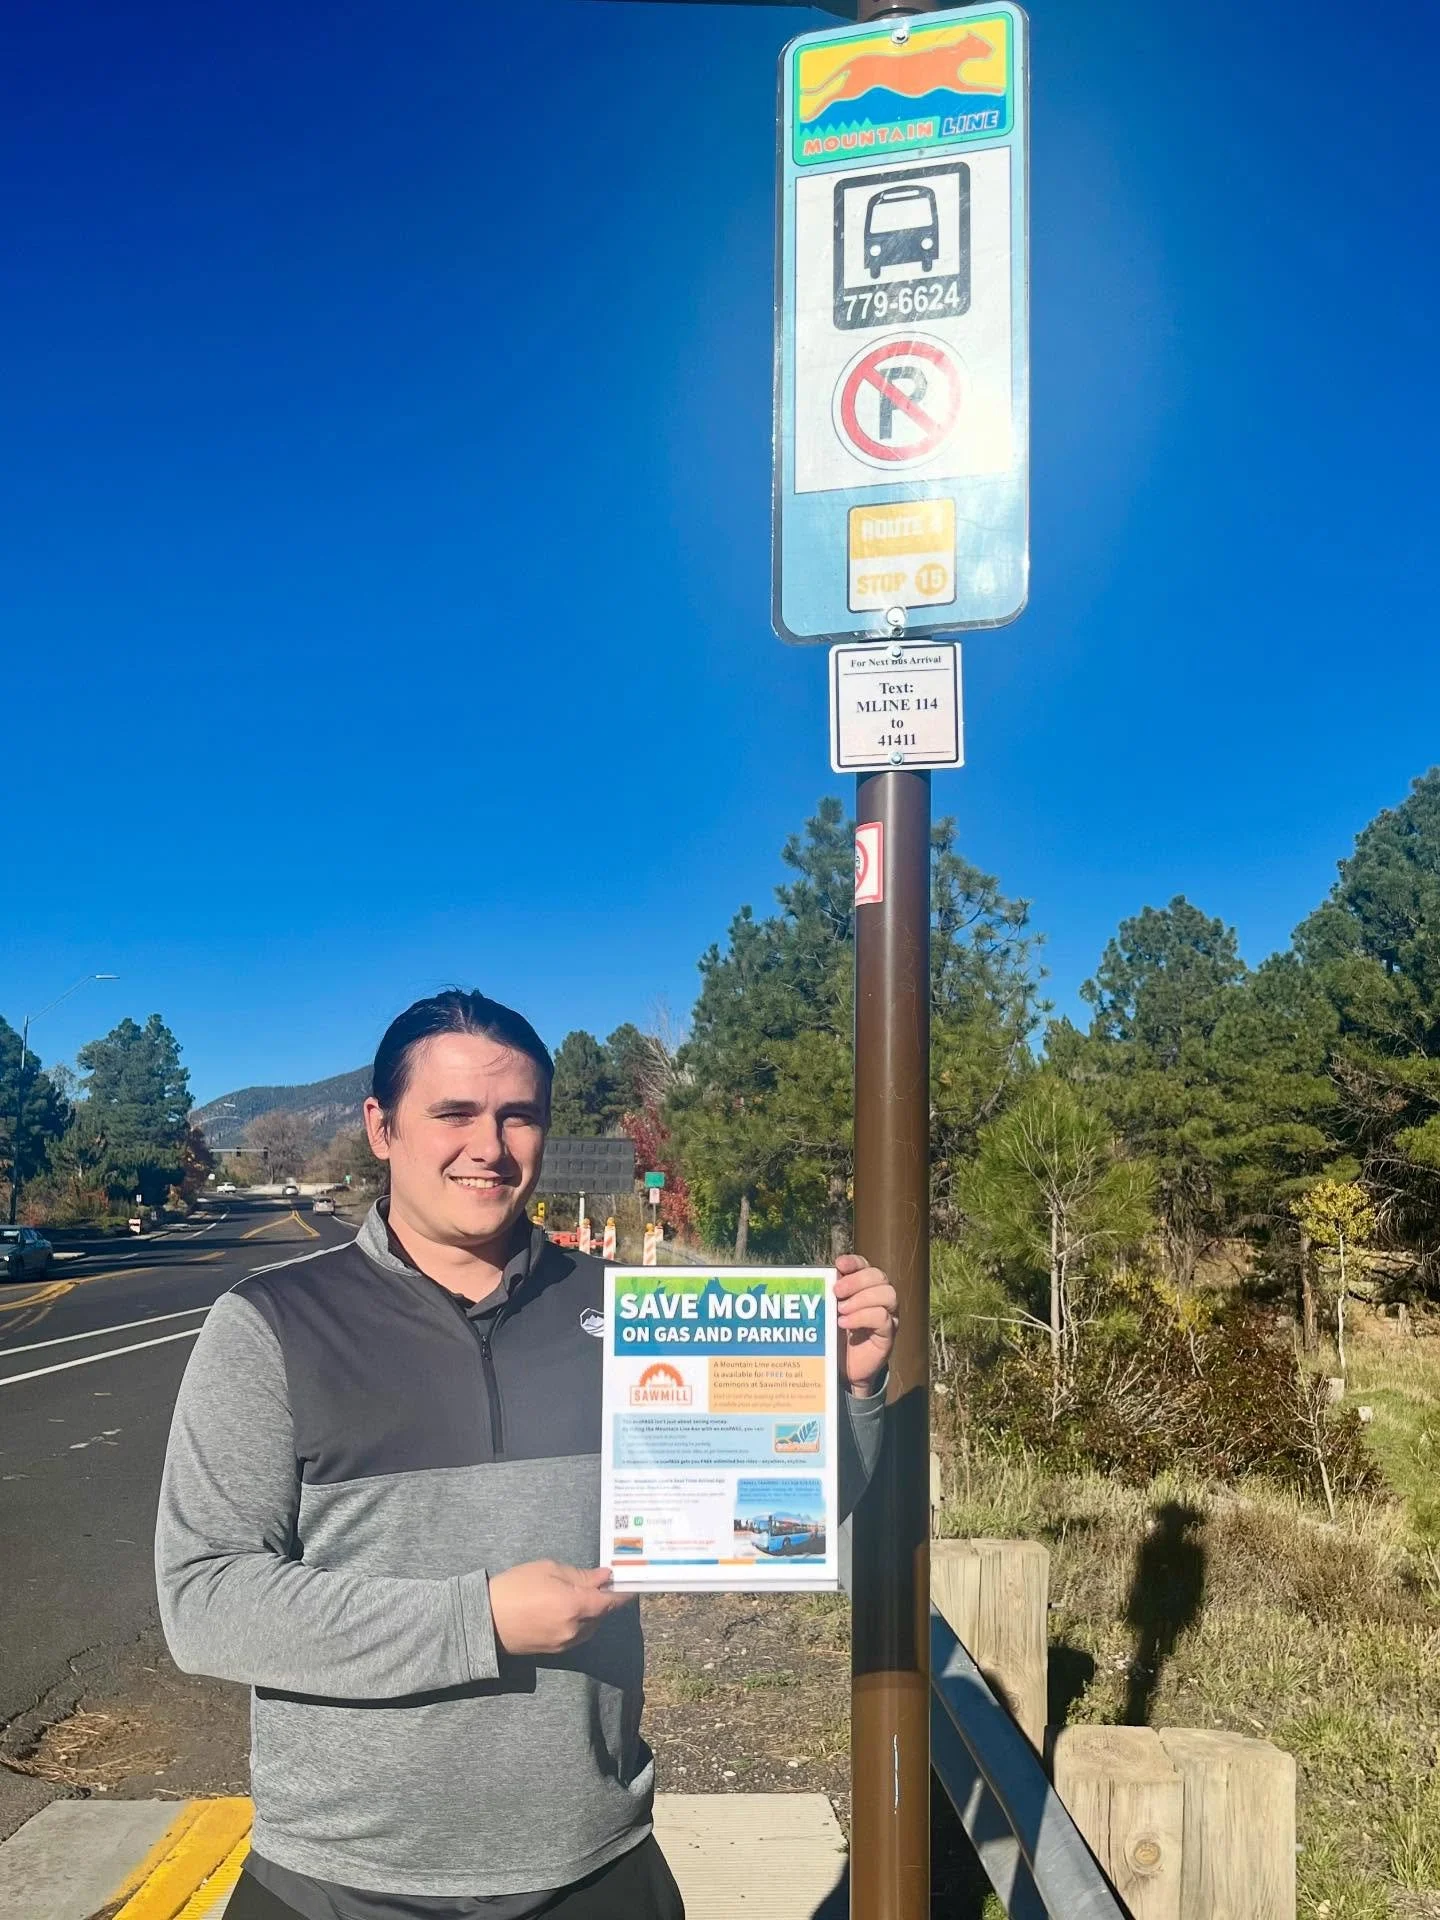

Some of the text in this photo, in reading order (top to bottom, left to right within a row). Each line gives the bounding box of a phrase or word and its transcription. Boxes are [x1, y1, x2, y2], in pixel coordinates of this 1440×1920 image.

[802, 110, 1000, 156] MOUNTAIN LINE
[843, 281, 961, 323] 779-6624
[861, 515, 925, 542] ROUTE
[857, 571, 908, 596] STOP
[851, 657, 867, 668] For
[868, 657, 889, 667] Next
[909, 655, 942, 666] Arrival
[878, 682, 914, 695] Text:
[856, 697, 938, 714] MLINE 114
[890, 718, 904, 730] to
[877, 733, 917, 747] 41411
[619, 1293, 822, 1321] SAVE MONEY
[622, 1327, 818, 1343] ON GAS AND PARKING
[633, 1390, 689, 1403] SAWMILL
